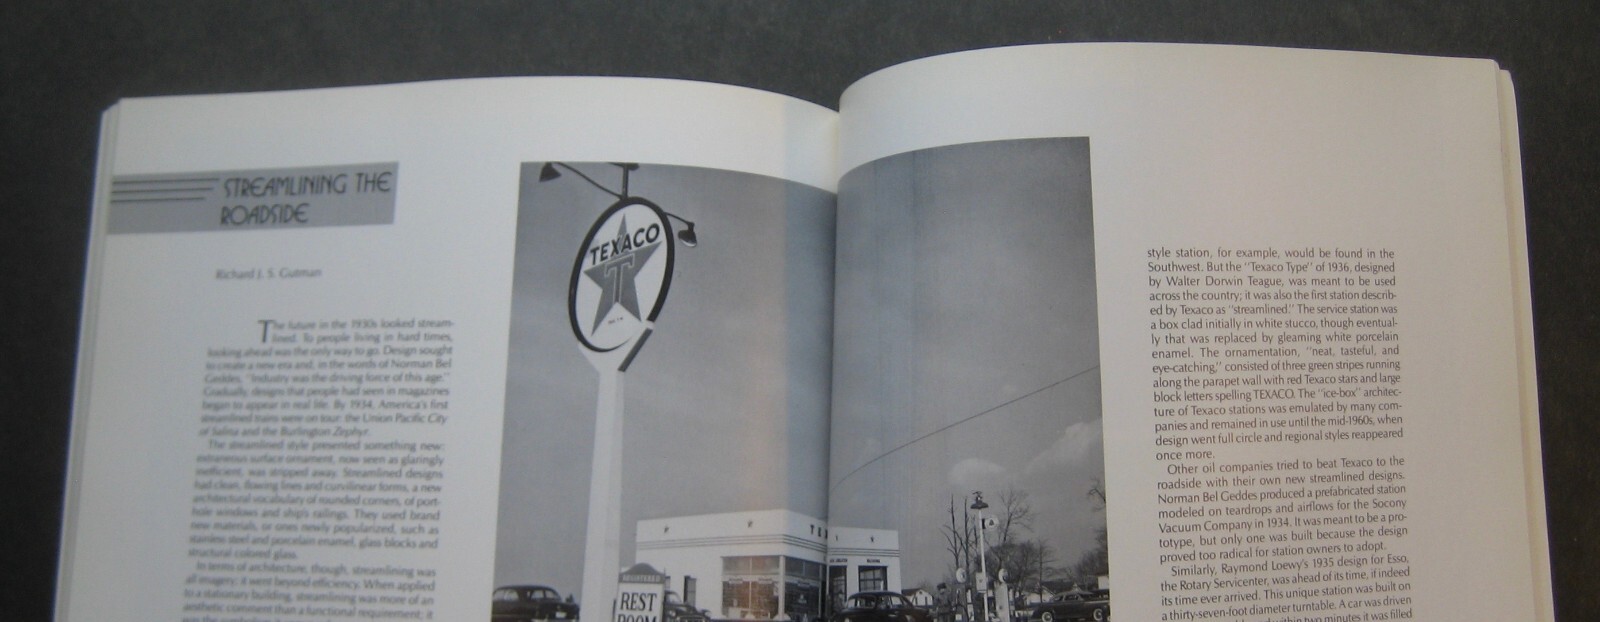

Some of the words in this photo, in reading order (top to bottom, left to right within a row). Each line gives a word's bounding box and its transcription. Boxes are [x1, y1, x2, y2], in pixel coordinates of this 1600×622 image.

[223, 172, 348, 198] STREAMLINING
[355, 171, 393, 193] THE
[220, 202, 310, 226] ROADSIDE
[590, 223, 660, 265] TEXACO
[1147, 248, 1171, 260] style
[1175, 248, 1216, 259] station,
[1217, 248, 1231, 258] for
[1235, 248, 1281, 260] example,
[1284, 248, 1315, 258] would
[1318, 248, 1331, 258] be
[1334, 248, 1363, 258] found
[1366, 249, 1376, 258] in
[1379, 249, 1394, 258] the
[215, 267, 255, 280] Richard
[257, 268, 264, 280] J.
[267, 267, 277, 279] S.
[279, 267, 322, 279] Gutman
[1148, 262, 1205, 272] Southwest.
[1206, 262, 1224, 272] But
[1224, 262, 1242, 272] the
[1315, 263, 1325, 273] of
[1328, 263, 1353, 274] 1936,
[1353, 263, 1395, 275] designed
[1148, 277, 1161, 289] by
[1166, 277, 1200, 286] Walter
[1204, 277, 1243, 286] Dorwin
[1248, 276, 1286, 289] Teague,
[1310, 276, 1341, 286] meant
[1344, 276, 1355, 286] to
[1358, 276, 1370, 286] be
[1374, 276, 1396, 286] used
[1151, 334, 1163, 346] ly
[1164, 334, 1185, 344] that
[1189, 336, 1210, 344] was
[1213, 333, 1257, 346] replaced
[1261, 333, 1273, 345] by
[1277, 332, 1322, 345] gleaming
[1325, 332, 1352, 342] white
[1355, 332, 1399, 344] porcelain
[1151, 348, 1198, 358] enamel.
[1200, 348, 1220, 358] The
[1224, 347, 1301, 358] ornamentation,
[1302, 346, 1336, 357] "neat,
[1340, 346, 1380, 357] tasteful,
[1381, 345, 1399, 355] and
[1224, 361, 1269, 372] consisted
[1270, 361, 1281, 371] of
[1280, 361, 1306, 371] three
[1307, 363, 1334, 373] green
[1335, 360, 1364, 372] stripes
[1365, 359, 1400, 372] running
[1153, 391, 1182, 401] block
[1183, 390, 1213, 401] letters
[1214, 390, 1252, 403] spelling
[1254, 389, 1297, 399] TEXACO.
[1298, 388, 1315, 398] The
[1363, 387, 1401, 397] architec-
[1155, 435, 1189, 448] design
[1190, 434, 1216, 445] went
[1217, 434, 1234, 444] full
[1235, 433, 1262, 443] circle
[1264, 432, 1283, 442] and
[1284, 431, 1323, 444] regional
[1324, 430, 1349, 443] styles
[1351, 429, 1404, 442] reappeared
[1155, 452, 1182, 460] once
[1157, 478, 1202, 490] roadside
[1205, 477, 1228, 488] with
[1231, 476, 1255, 487] their
[1258, 478, 1281, 486] own
[1309, 472, 1365, 484] streamlined
[1368, 470, 1405, 484] designs.
[1157, 492, 1200, 504] Norman
[1202, 492, 1218, 502] Bel
[1220, 490, 1258, 501] Geddes
[1259, 488, 1305, 502] produced
[1306, 490, 1312, 498] a
[1314, 485, 1375, 500] prefabricated
[1376, 484, 1406, 495] station
[1158, 507, 1205, 518] modeled
[1225, 504, 1272, 518] teardrops
[1275, 503, 1294, 514] and
[1296, 502, 1333, 513] airflows
[1336, 501, 1350, 511] for
[1353, 500, 1369, 510] the
[1372, 499, 1406, 512] Socony
[1159, 536, 1198, 551] totype,
[1199, 536, 1217, 546] but
[1220, 534, 1243, 547] only
[1245, 536, 1265, 544] one
[1268, 534, 1287, 542] was
[1290, 530, 1313, 541] built
[1316, 528, 1355, 540] because
[1358, 527, 1374, 538] the
[1377, 526, 1408, 539] design
[1159, 551, 1196, 565] proved
[1198, 550, 1216, 560] too
[1218, 548, 1252, 559] radical
[1254, 547, 1268, 557] for
[1271, 545, 1304, 556] station
[1305, 545, 1341, 554] owners
[1343, 542, 1354, 552] to
[1356, 540, 1386, 554] adopt.
[1170, 564, 1220, 579] Similarly,
[1220, 561, 1268, 576] Raymond
[1270, 559, 1308, 573] Loewy's
[1312, 558, 1334, 568] 1935
[1336, 556, 1368, 570] design
[1370, 555, 1383, 565] for
[1386, 554, 1409, 566] Esso,
[620, 592, 657, 611] REST
[1169, 605, 1248, 622] thirty-seven-foot
[1248, 602, 1290, 615] diameter
[1292, 600, 1337, 612] turntable.
[1338, 599, 1346, 609] A
[1347, 600, 1361, 608] car
[1364, 599, 1381, 607] was
[1382, 595, 1412, 606] driven
